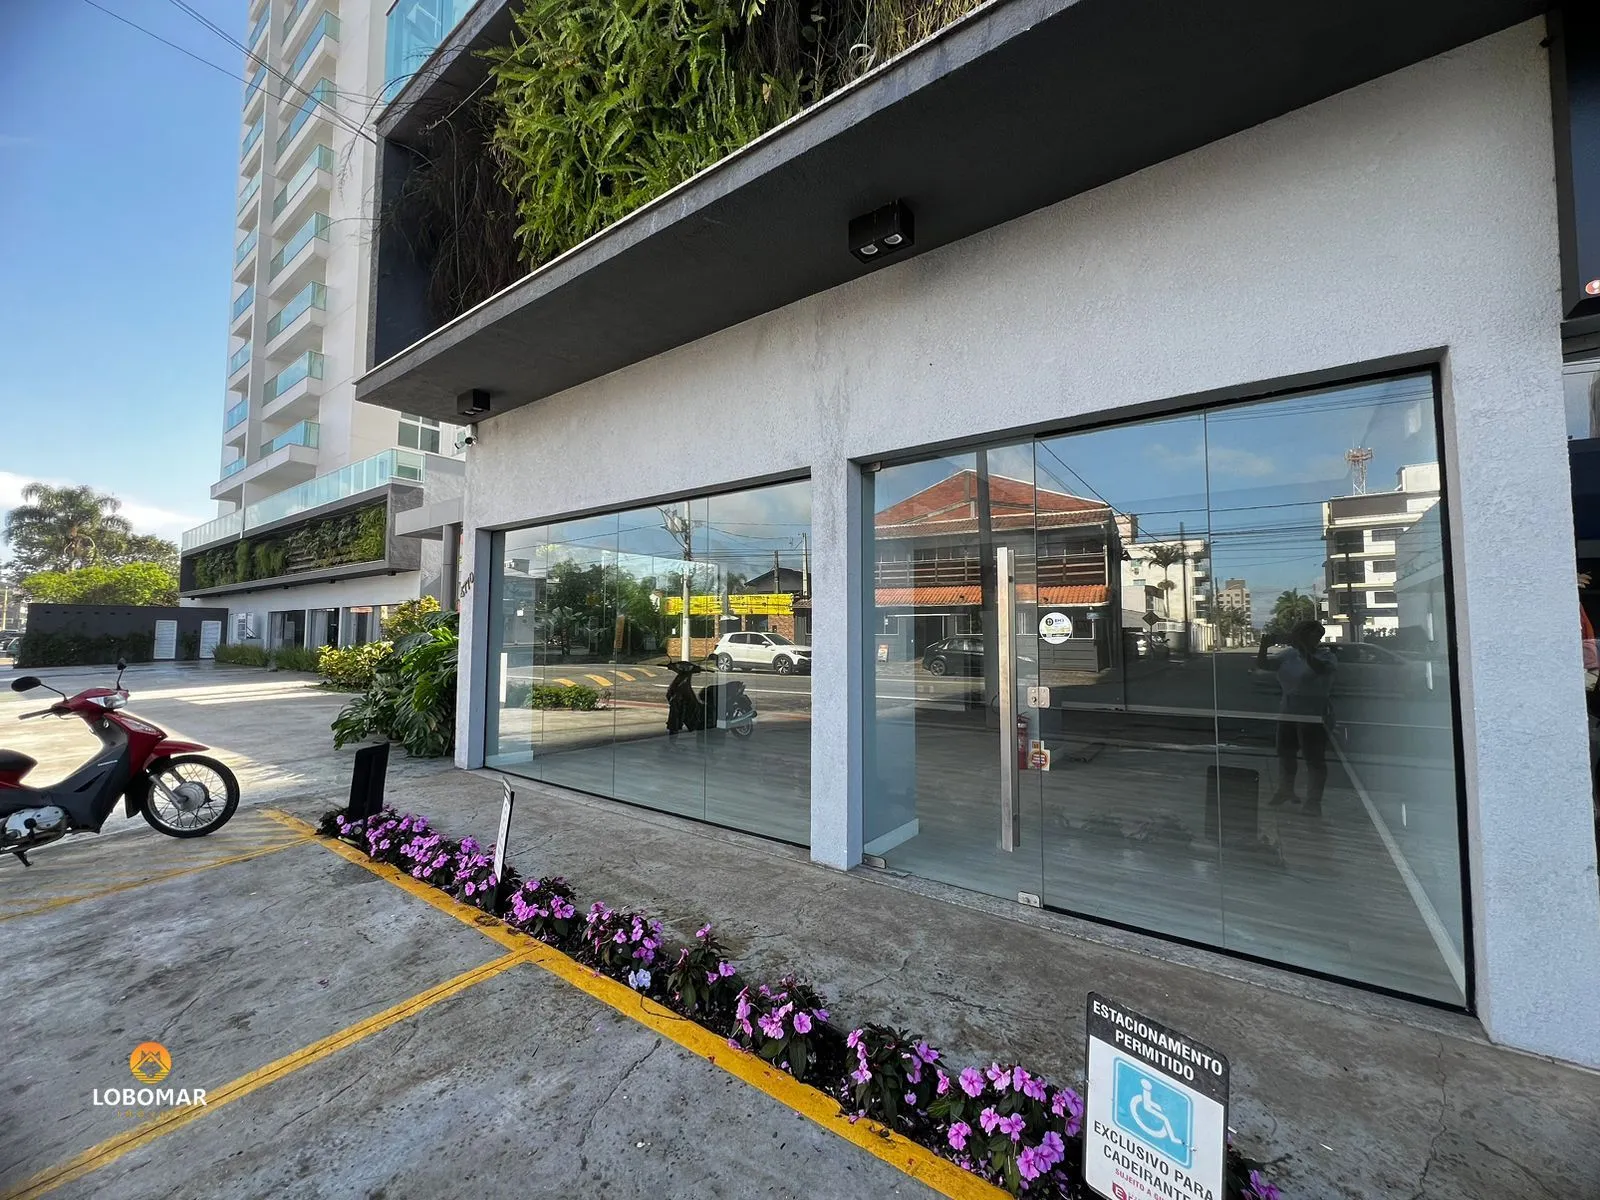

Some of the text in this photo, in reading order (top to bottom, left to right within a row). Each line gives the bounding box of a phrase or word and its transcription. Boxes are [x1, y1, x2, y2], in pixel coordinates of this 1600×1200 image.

[1093, 1000, 1223, 1076] ESTACIONAMENTO
[1115, 1029, 1195, 1081] PERMITIDO
[1094, 1120, 1214, 1200] EXCLUSIVO PARA
[1115, 1168, 1145, 1192] SUJEITO
